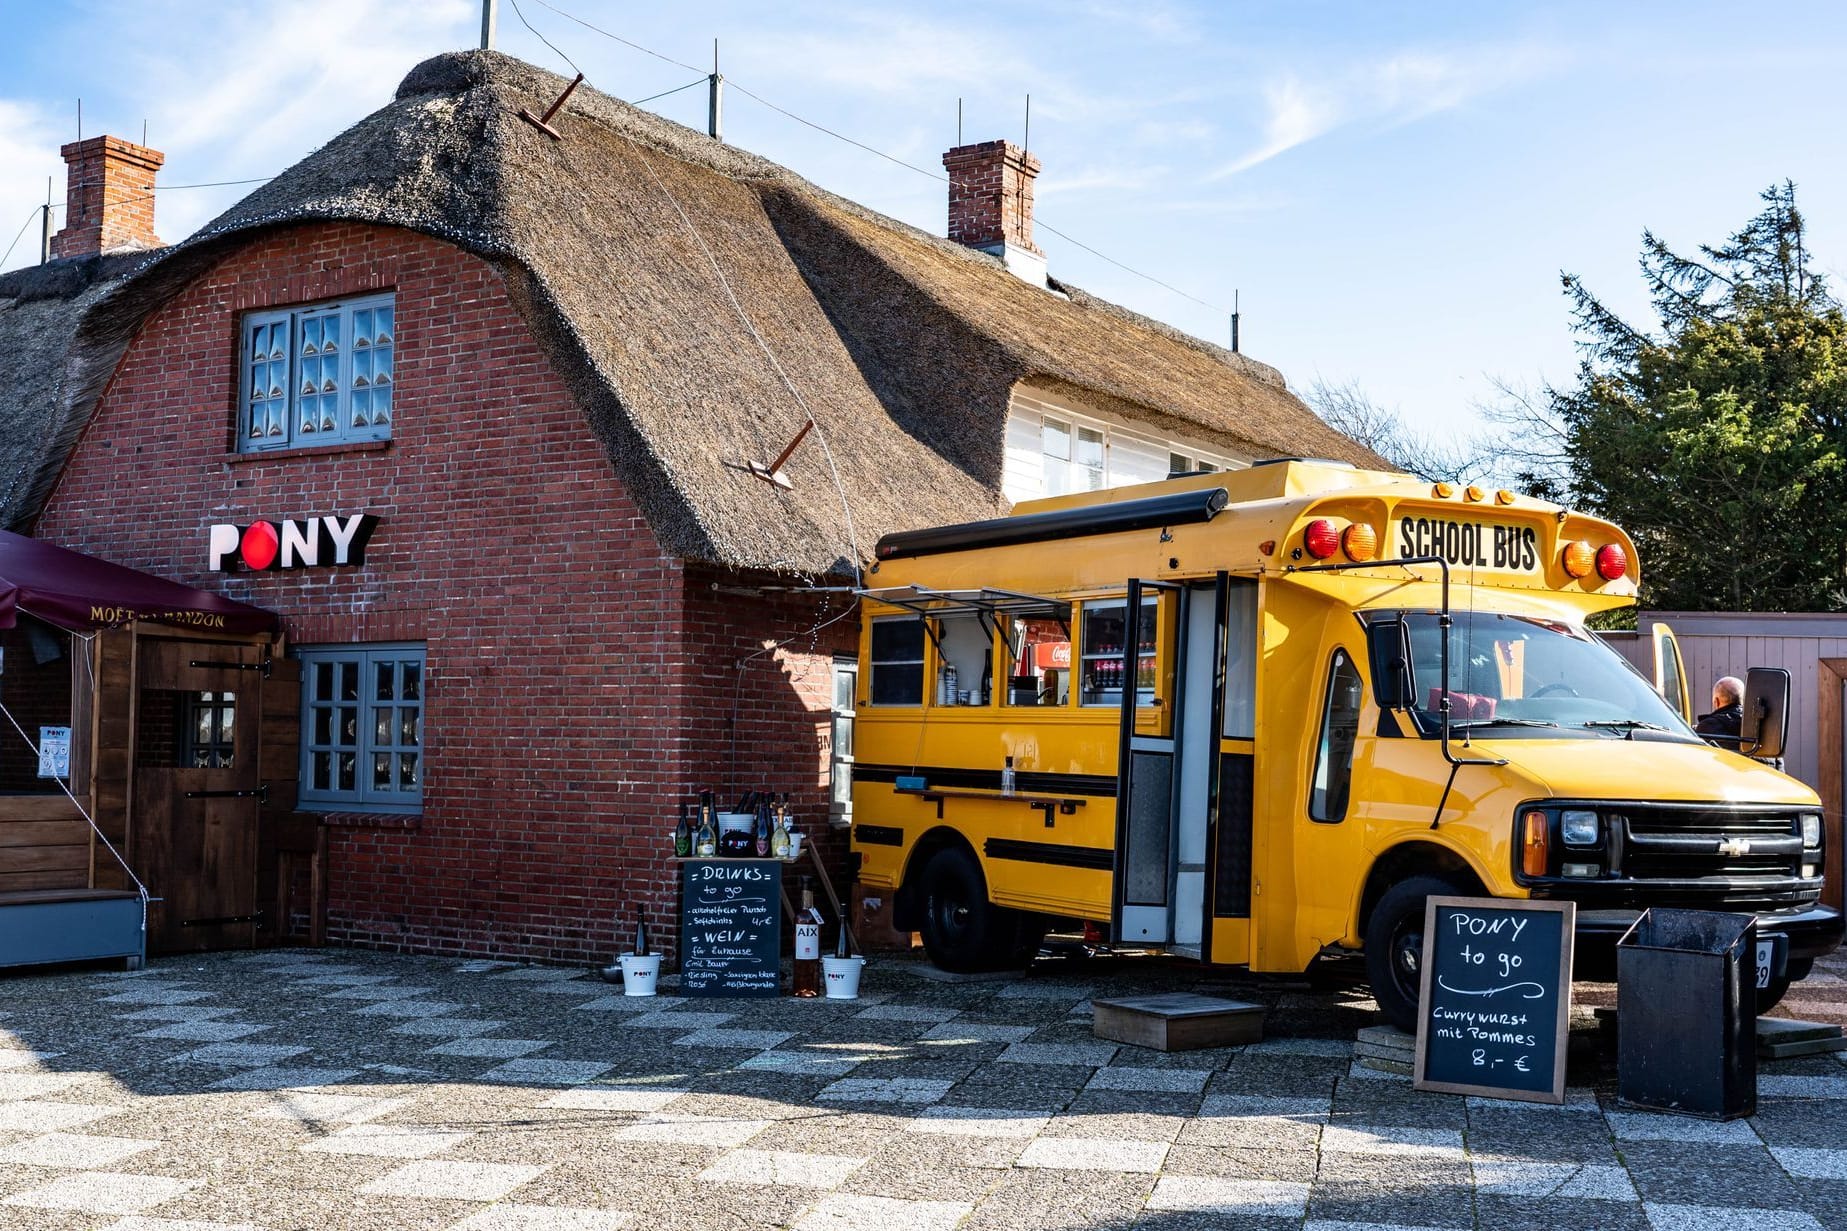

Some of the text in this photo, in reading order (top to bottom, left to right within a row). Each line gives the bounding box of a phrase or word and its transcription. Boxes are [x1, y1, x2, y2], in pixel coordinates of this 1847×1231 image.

[209, 513, 365, 572] PONY
[1400, 516, 1536, 571] SCHOOL BUS
[701, 866, 762, 881] DRINKS
[703, 885, 742, 899] to go
[705, 930, 745, 943] WEIN
[797, 927, 818, 937] AIX
[1449, 913, 1528, 942] PONY
[1460, 945, 1522, 977] to go
[1437, 1026, 1536, 1047] mit Pommes
